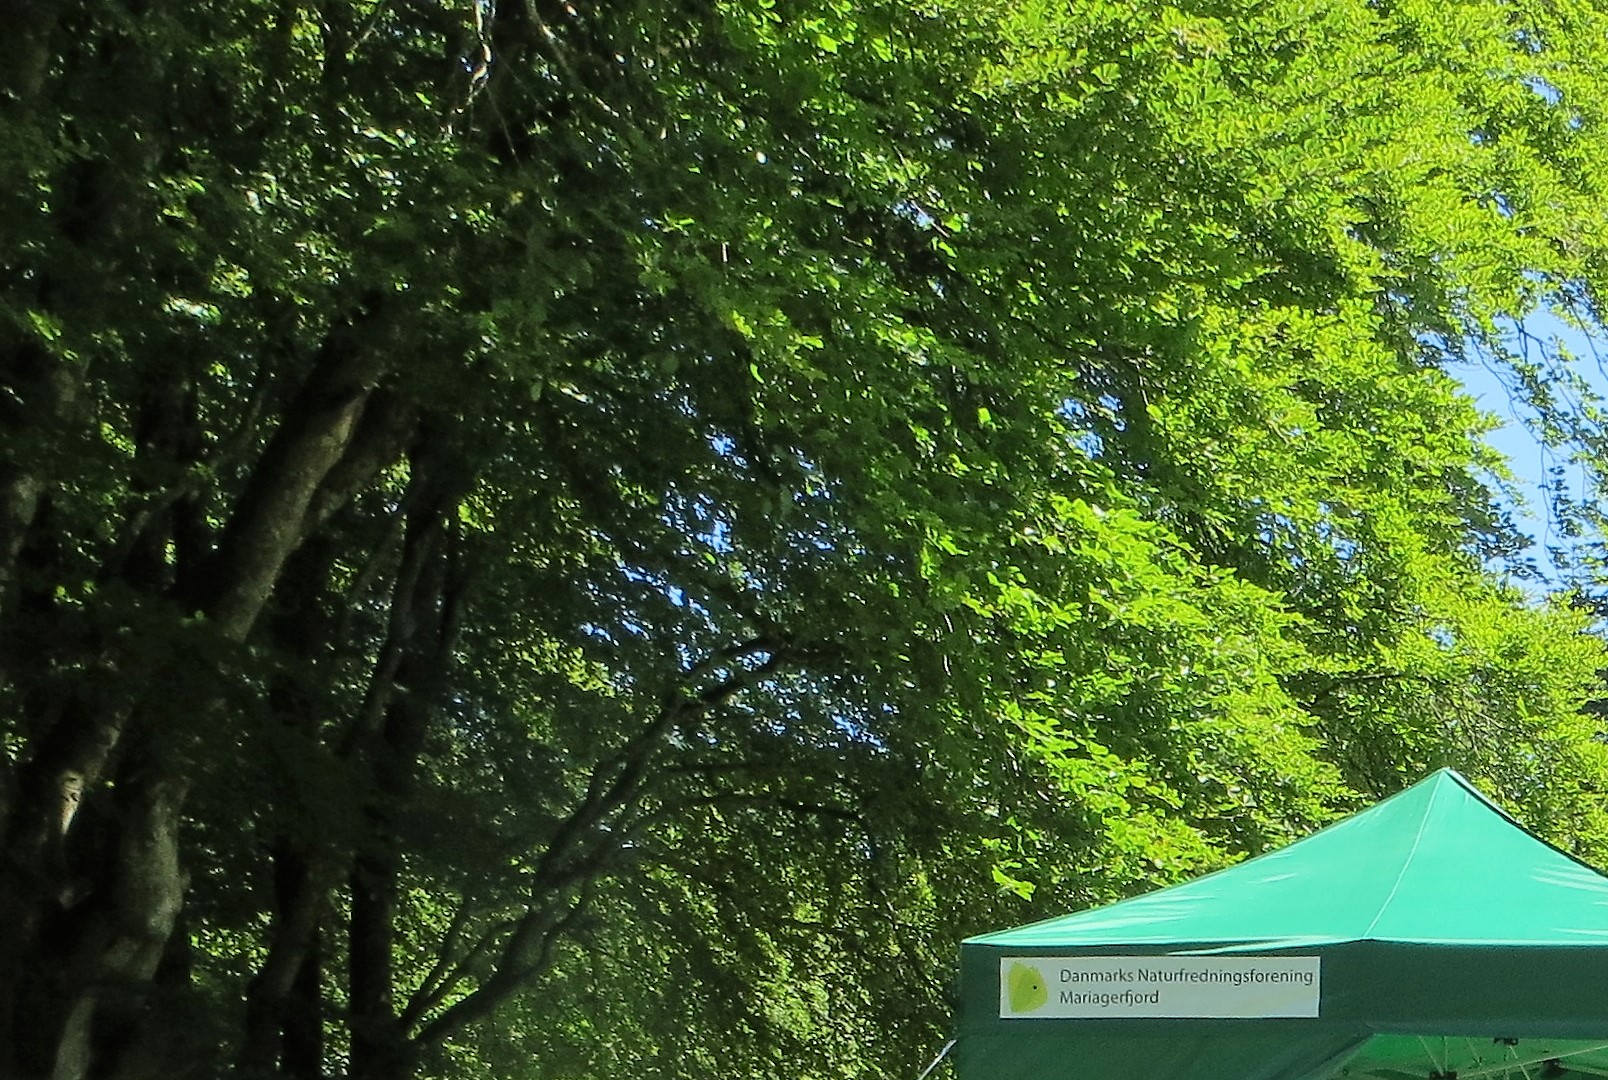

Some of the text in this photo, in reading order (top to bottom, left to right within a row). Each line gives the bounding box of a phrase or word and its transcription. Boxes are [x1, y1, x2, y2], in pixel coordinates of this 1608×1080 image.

[1060, 968, 1314, 986] Danmarks Naturfredningsforening
[1060, 990, 1159, 1006] Mariagerfjord
